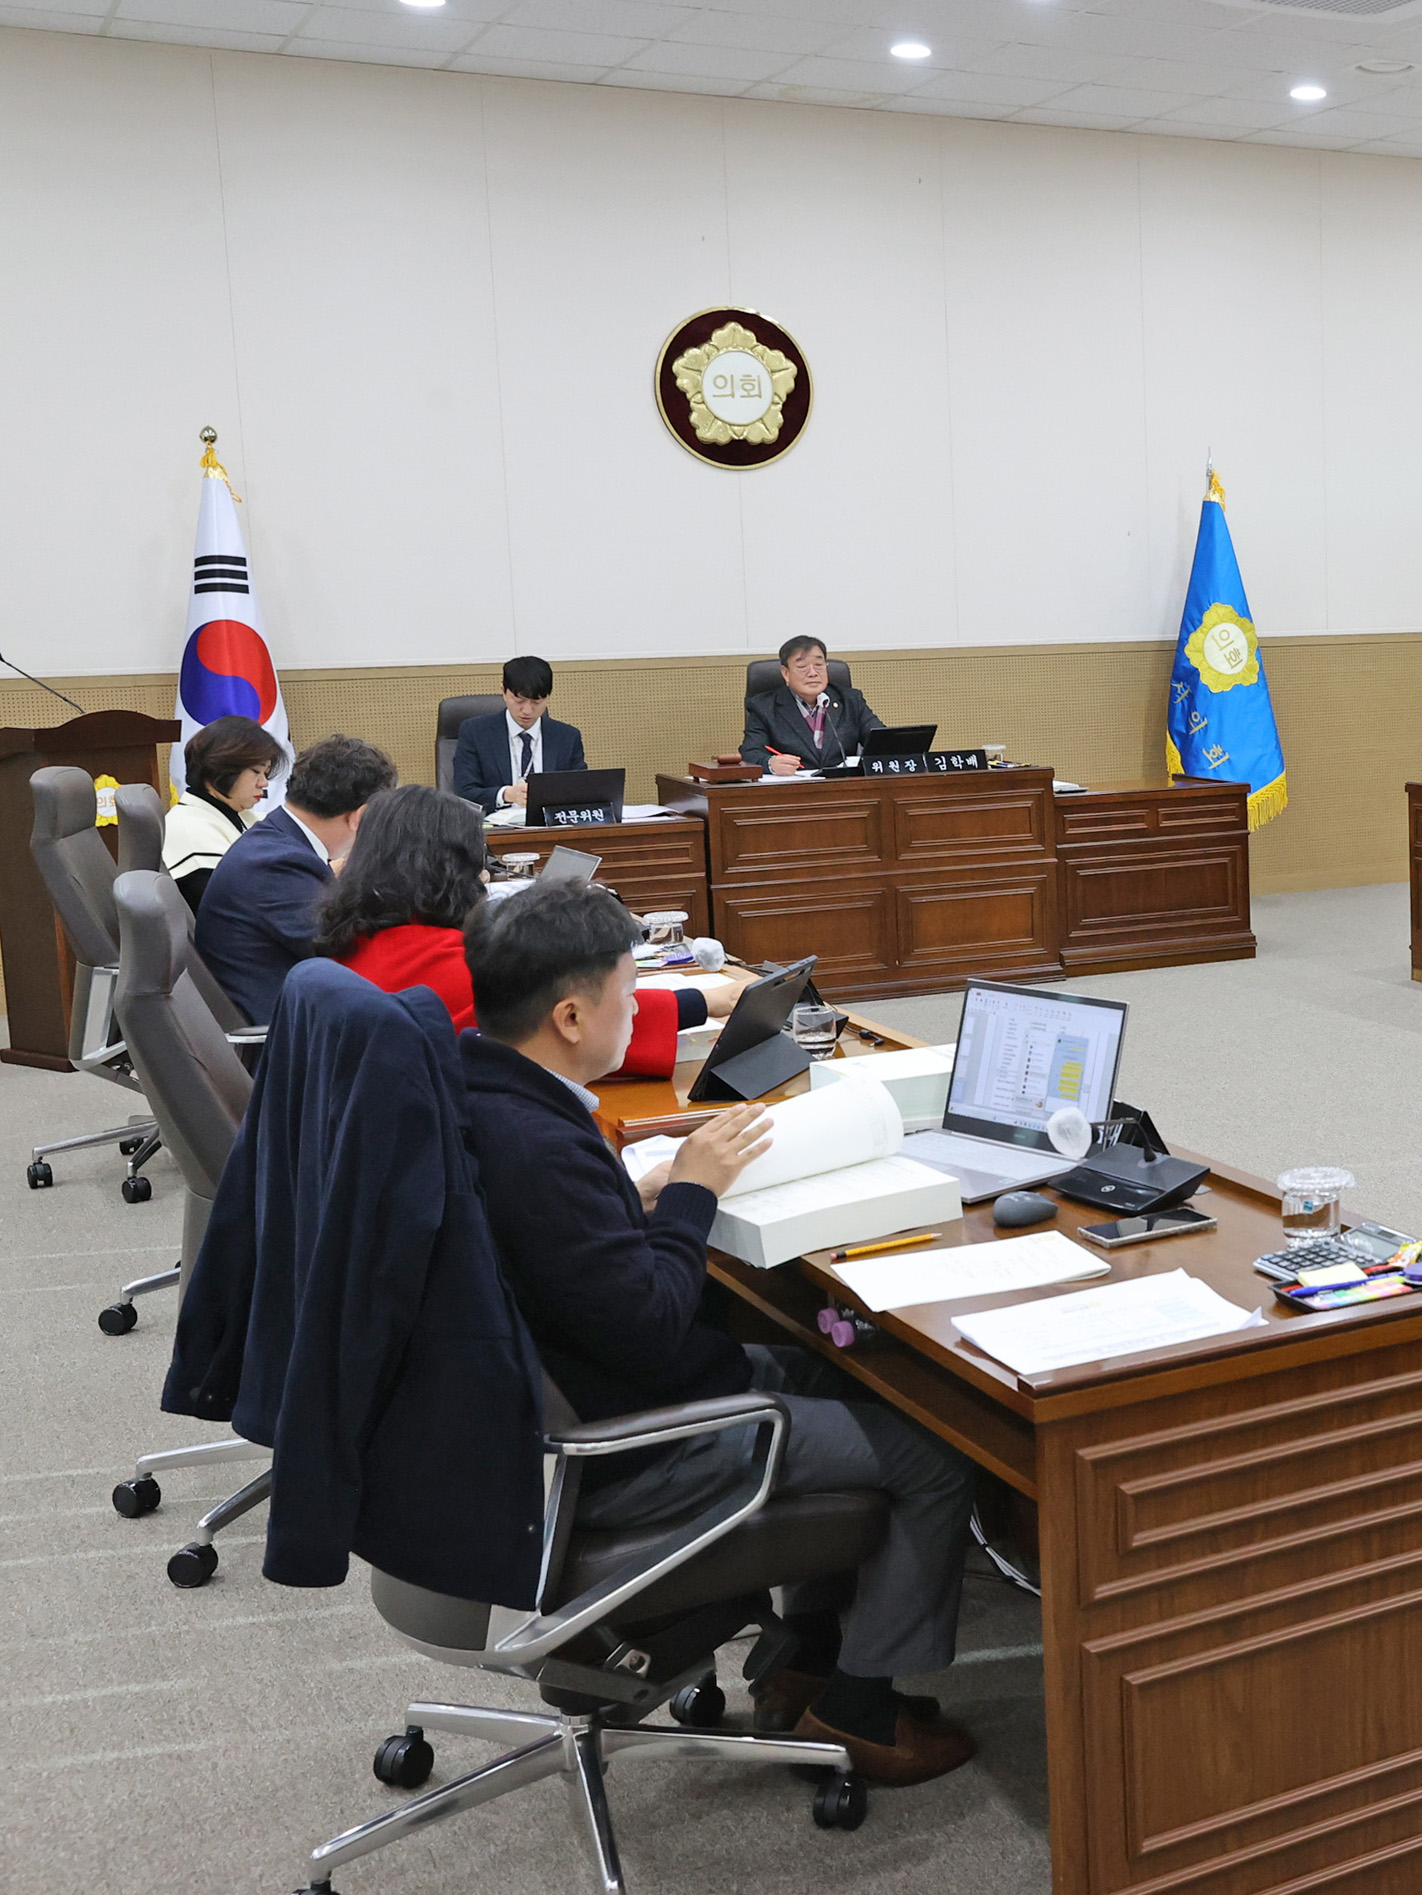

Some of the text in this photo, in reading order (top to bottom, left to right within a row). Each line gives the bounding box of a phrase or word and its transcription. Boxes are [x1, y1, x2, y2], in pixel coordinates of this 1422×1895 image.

[712, 374, 763, 399] 의회
[1211, 629, 1243, 669] 의회
[871, 754, 979, 774] 위원장 김학배
[554, 808, 605, 824] 전문위원
